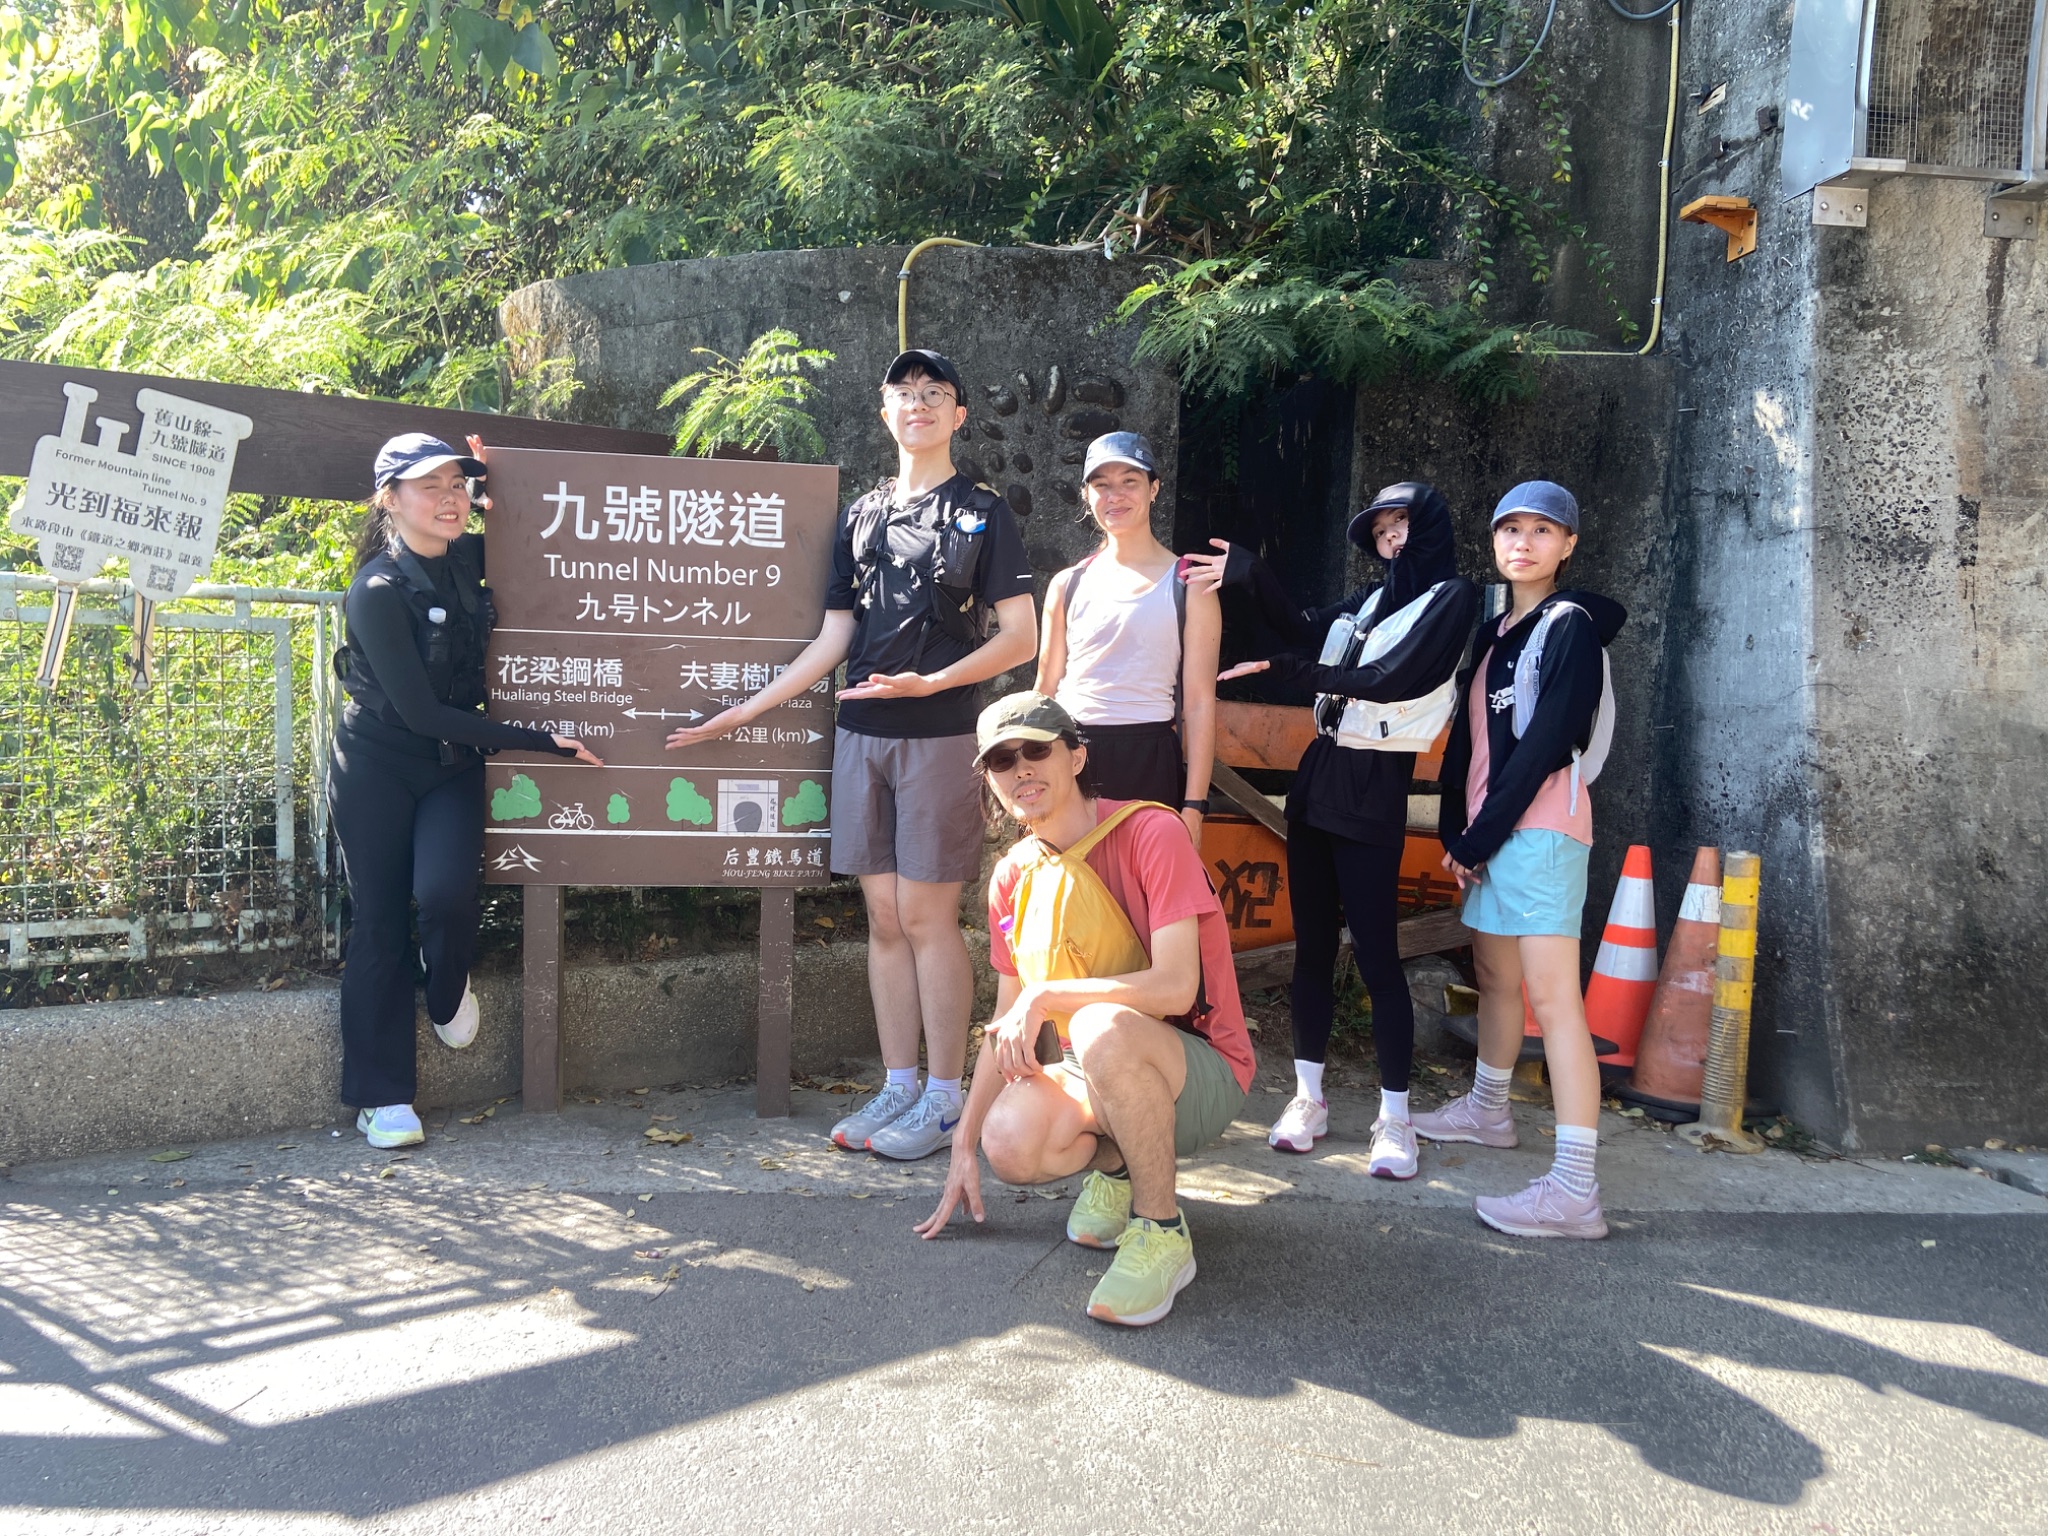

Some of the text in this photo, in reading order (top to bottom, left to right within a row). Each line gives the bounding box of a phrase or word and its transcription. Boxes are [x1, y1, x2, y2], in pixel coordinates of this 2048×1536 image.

[150, 430, 228, 463] 九號隧道
[55, 449, 172, 486] Former Mountain line
[151, 453, 216, 477] SINCE 1908
[142, 482, 207, 507] Tunnel No. 9
[45, 481, 203, 541] 光到福來報
[540, 481, 786, 549] 九號隧道
[543, 554, 781, 588] Tunnel Number 9
[576, 591, 751, 626] 九号トンネル
[498, 655, 623, 687] 花梁鋼橋
[680, 660, 830, 694] 夫妻樹
[491, 688, 633, 706] Hualiang Steel Bridge
[579, 720, 615, 738] (km)
[772, 727, 806, 745] (km)
[721, 868, 824, 879] HOU-FENG BIKE PATH
